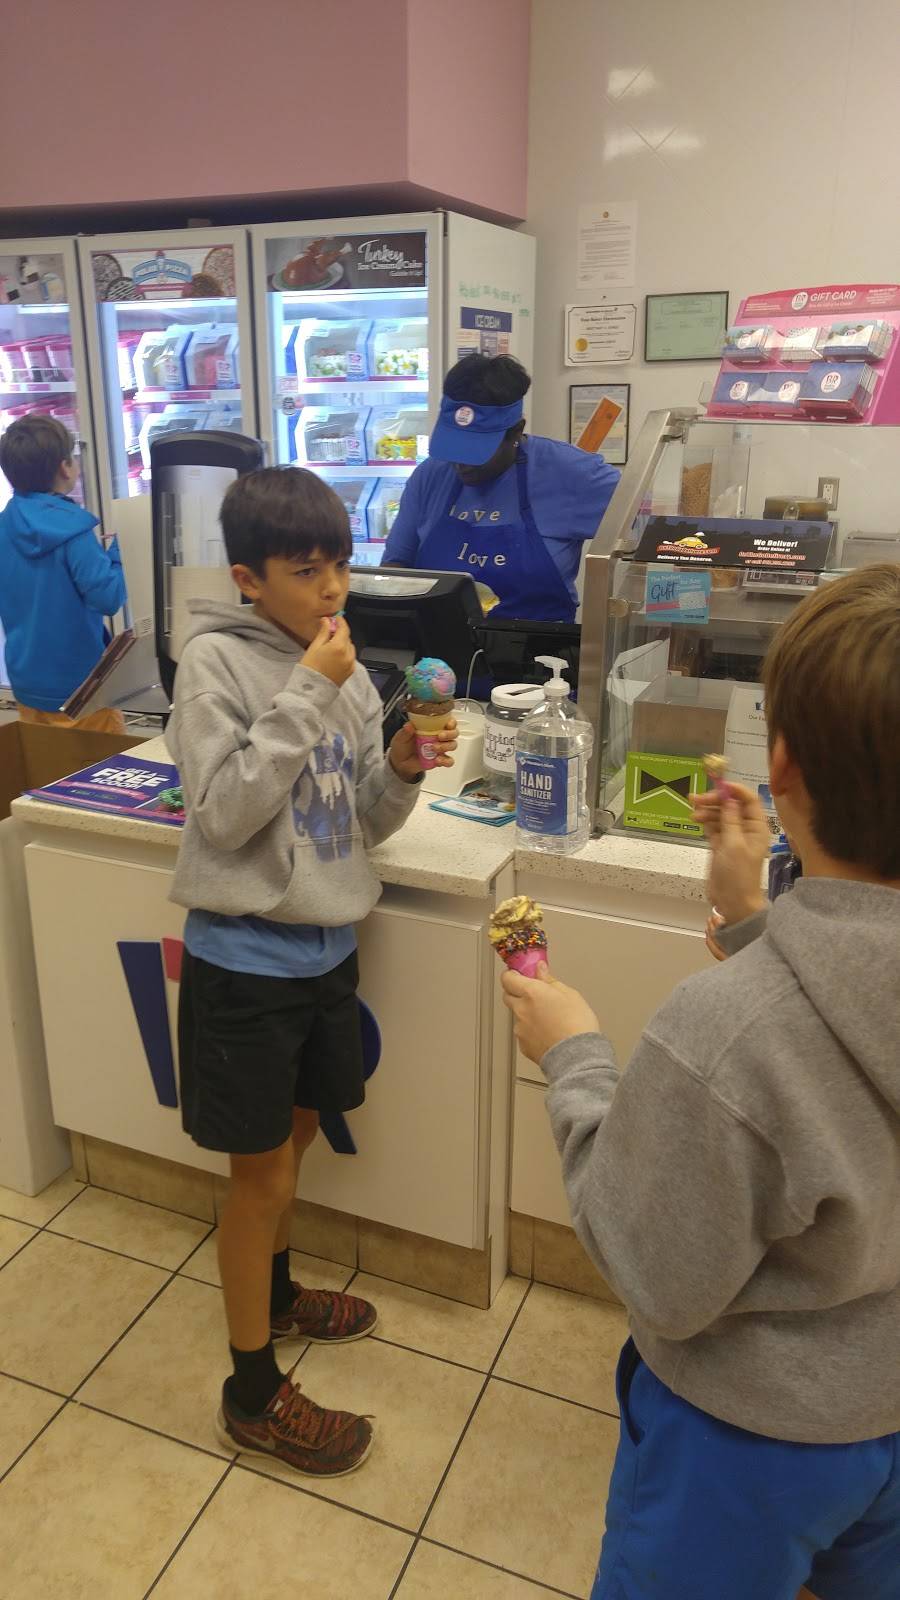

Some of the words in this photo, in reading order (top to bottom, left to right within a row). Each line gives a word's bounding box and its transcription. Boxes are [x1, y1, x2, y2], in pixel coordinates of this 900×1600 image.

[358, 239, 404, 264] Turkey
[810, 291, 829, 302] GIFT
[831, 290, 857, 301] CARD
[449, 504, 501, 522] love
[753, 539, 766, 547] We
[457, 543, 506, 568] love
[651, 580, 679, 602] Gift
[91, 767, 170, 788] FREE
[520, 770, 553, 791] HAND
[520, 786, 552, 801] SANITIZER
